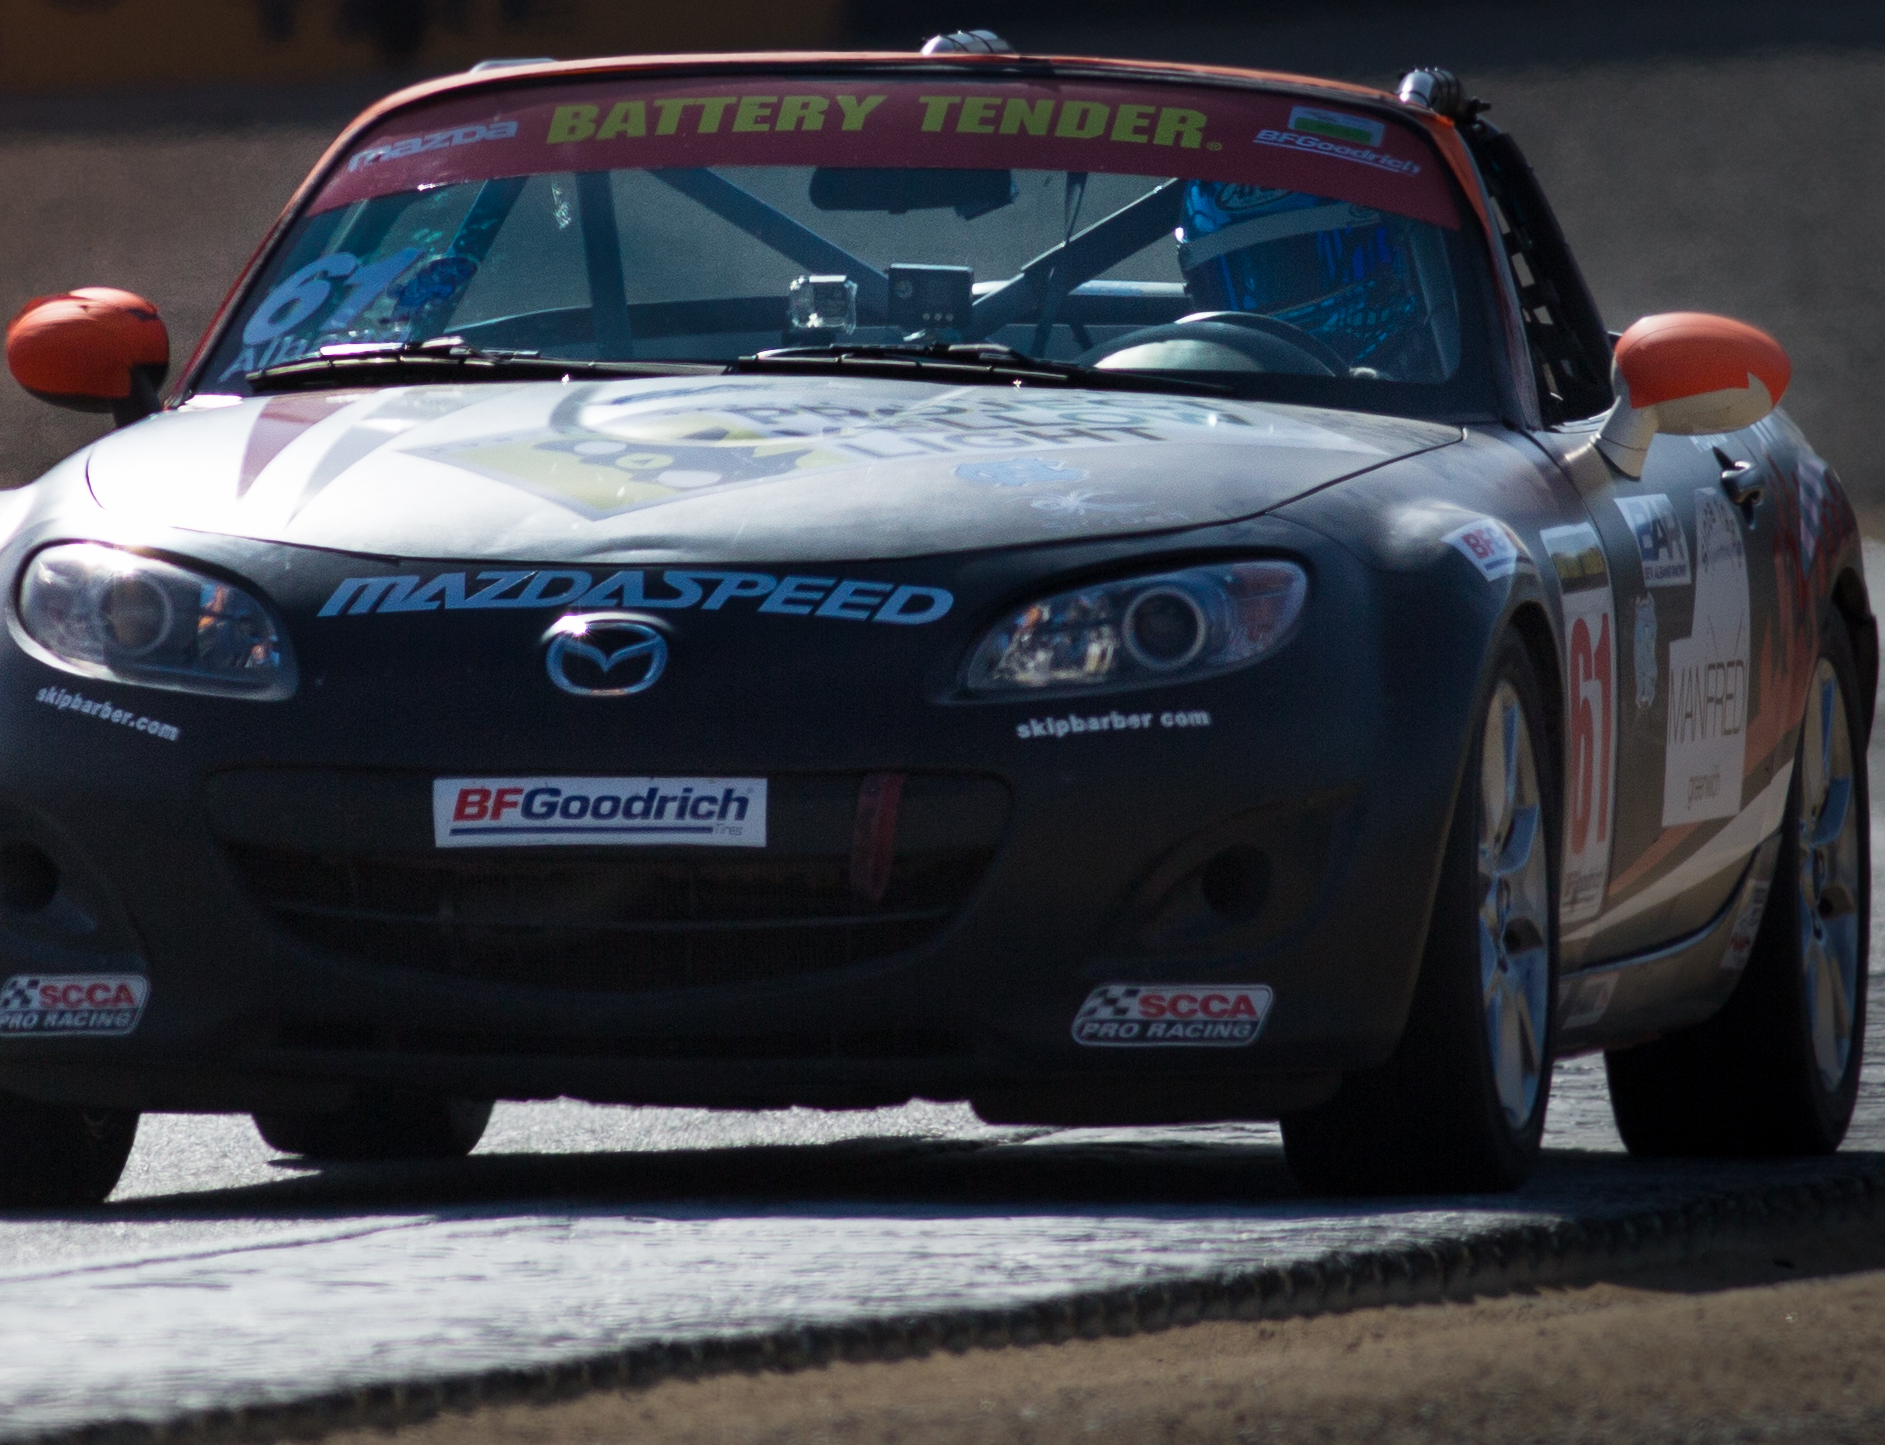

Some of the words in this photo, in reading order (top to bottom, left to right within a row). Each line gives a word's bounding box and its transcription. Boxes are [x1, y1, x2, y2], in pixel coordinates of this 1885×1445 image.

[546, 94, 888, 144] BATTERY
[1254, 129, 1422, 176] BFGoodrich
[242, 248, 425, 347] 61
[836, 426, 1168, 459] LIGHT
[316, 569, 954, 625] MAZDASPEED
[35, 685, 179, 741] skipbarber.com
[1570, 612, 1613, 855] 61
[452, 786, 750, 823] BFGoodrich
[39, 983, 136, 1009] SCCA
[1138, 993, 1259, 1019] SCCA
[43, 1011, 132, 1028] RACING
[1080, 1022, 1140, 1039] PRO
[1145, 1022, 1253, 1039] RACING
